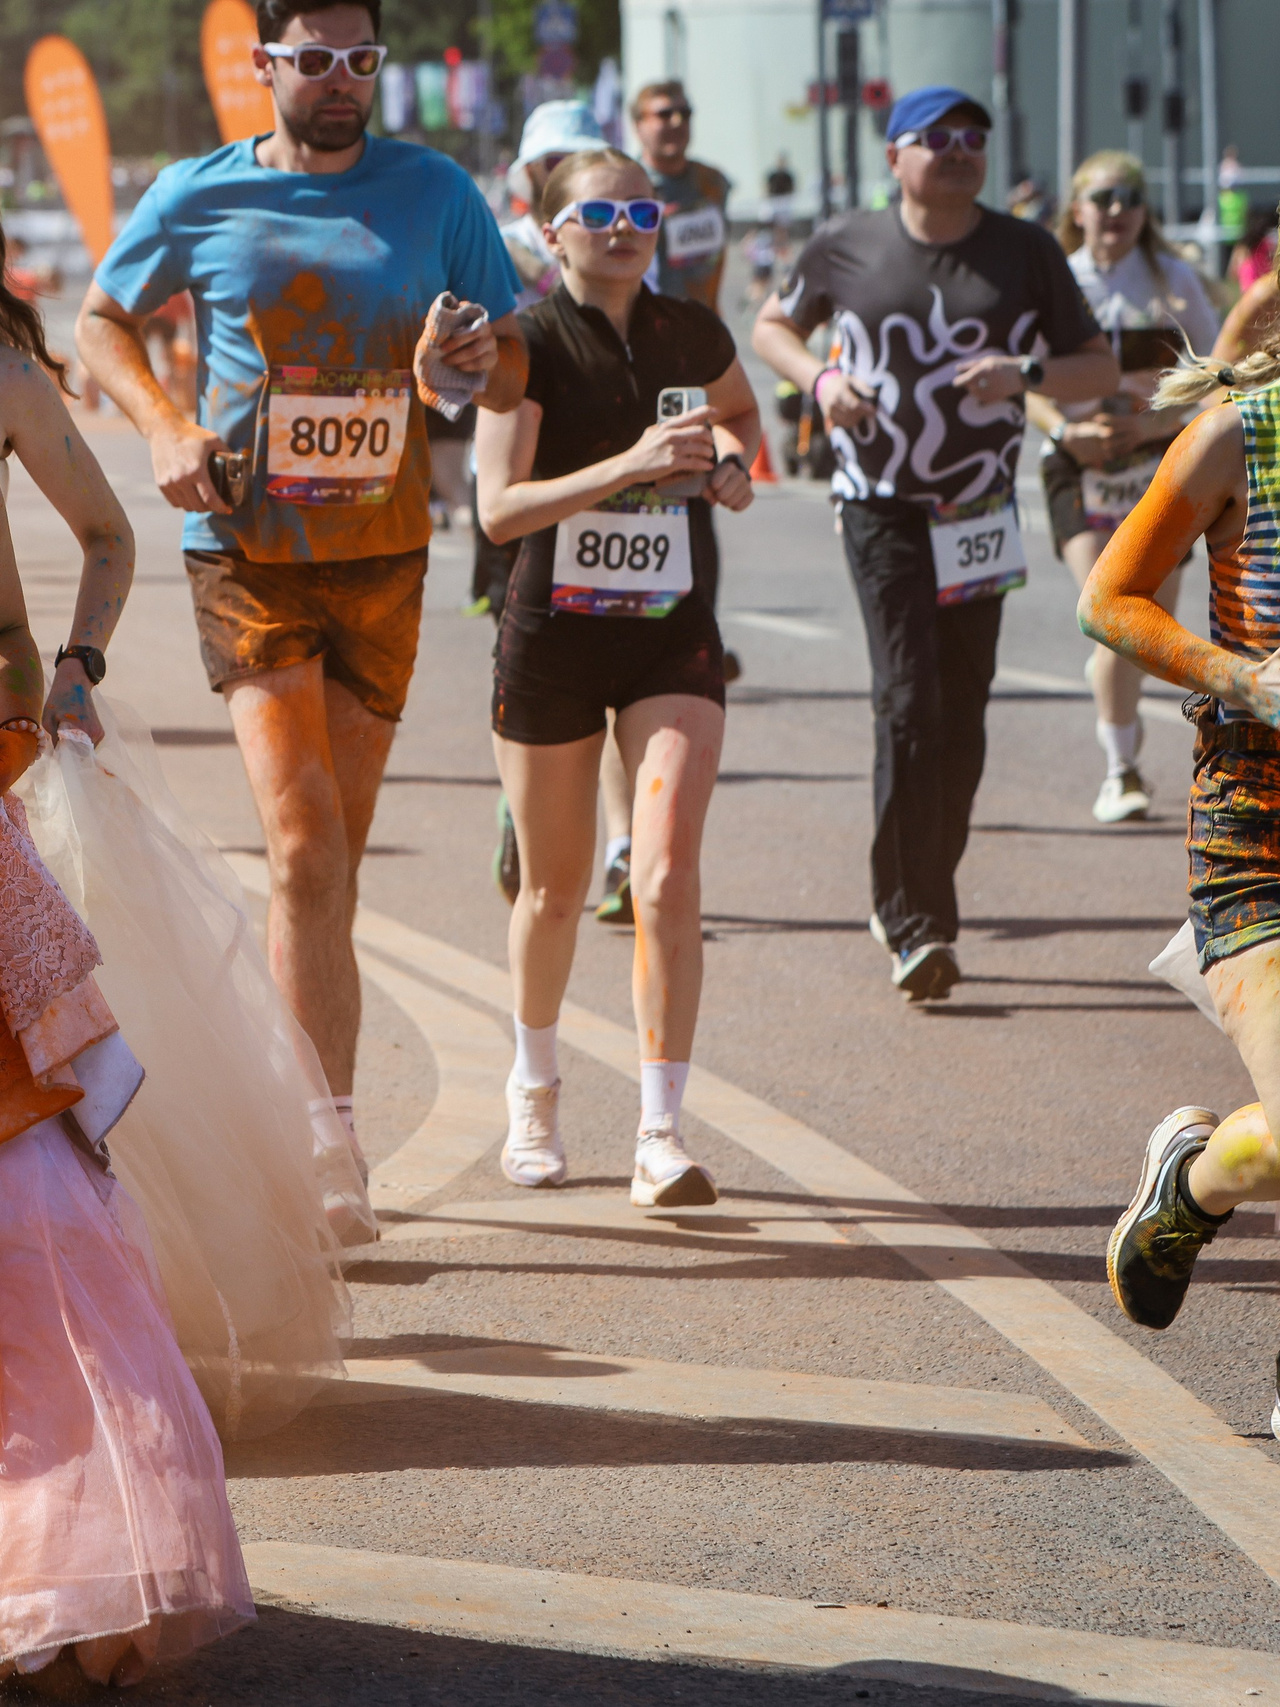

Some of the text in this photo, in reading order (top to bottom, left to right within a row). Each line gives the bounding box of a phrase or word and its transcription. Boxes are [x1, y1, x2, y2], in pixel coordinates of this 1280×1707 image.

[290, 416, 390, 457] 8090
[576, 529, 670, 572] 8089
[957, 527, 1005, 568] 357
